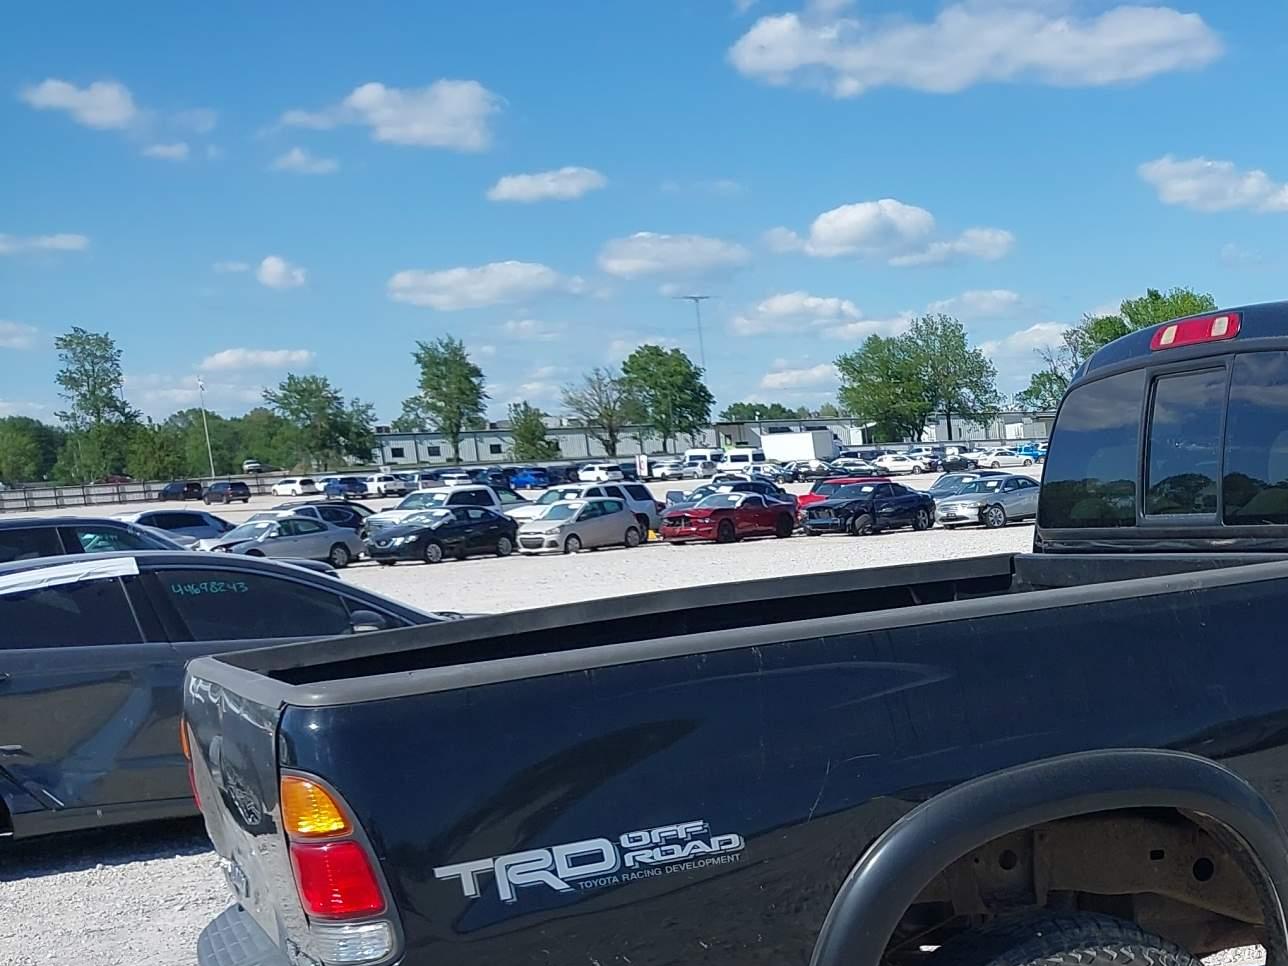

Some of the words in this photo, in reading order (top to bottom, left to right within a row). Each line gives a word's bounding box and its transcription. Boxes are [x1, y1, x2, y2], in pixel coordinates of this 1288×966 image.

[171, 581, 249, 595] 44698243
[618, 820, 709, 849] OFF
[431, 837, 623, 903] TRD
[622, 832, 745, 868] ROAD
[577, 875, 620, 890] TOYOTA
[621, 867, 663, 883] RACING
[664, 853, 744, 875] DEVELOPMENT
